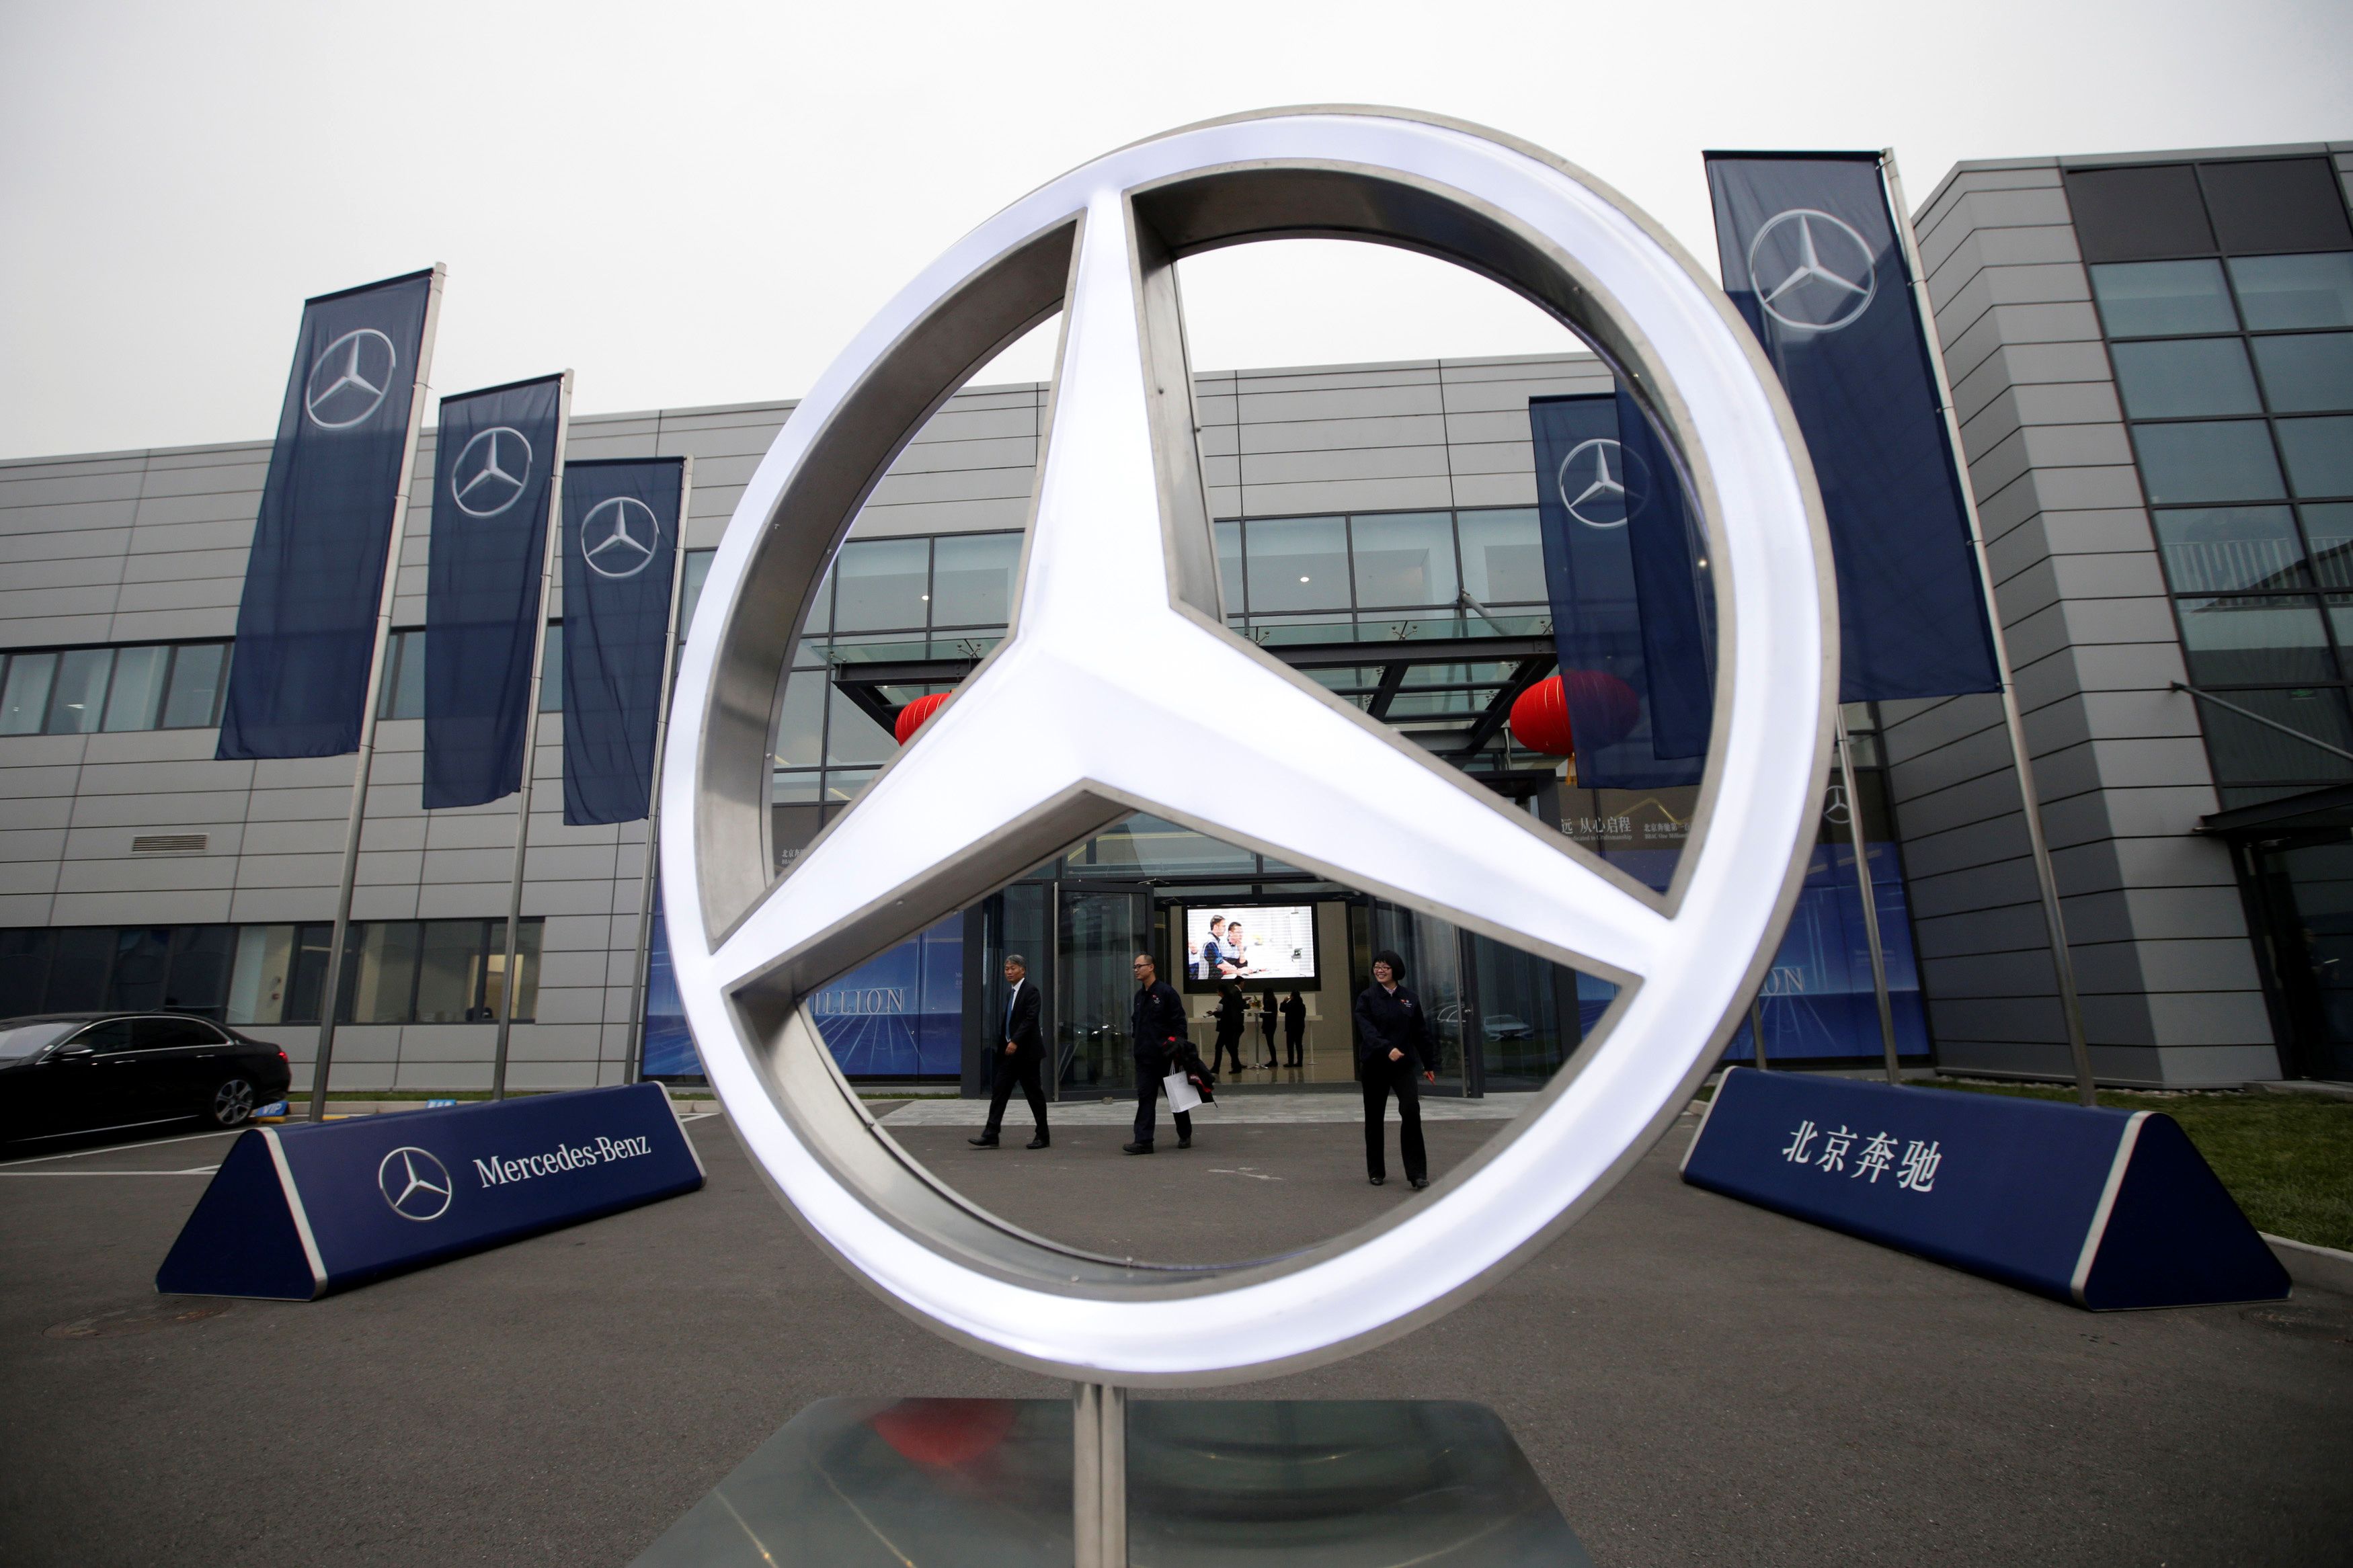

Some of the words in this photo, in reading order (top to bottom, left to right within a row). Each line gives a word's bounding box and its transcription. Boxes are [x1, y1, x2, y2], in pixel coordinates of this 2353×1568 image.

[1561, 818, 1573, 834] 远
[1581, 816, 1632, 833] 从心启程
[473, 1136, 651, 1188] Mercedes-Benz
[1782, 1120, 1942, 1192] 北京奔驰
